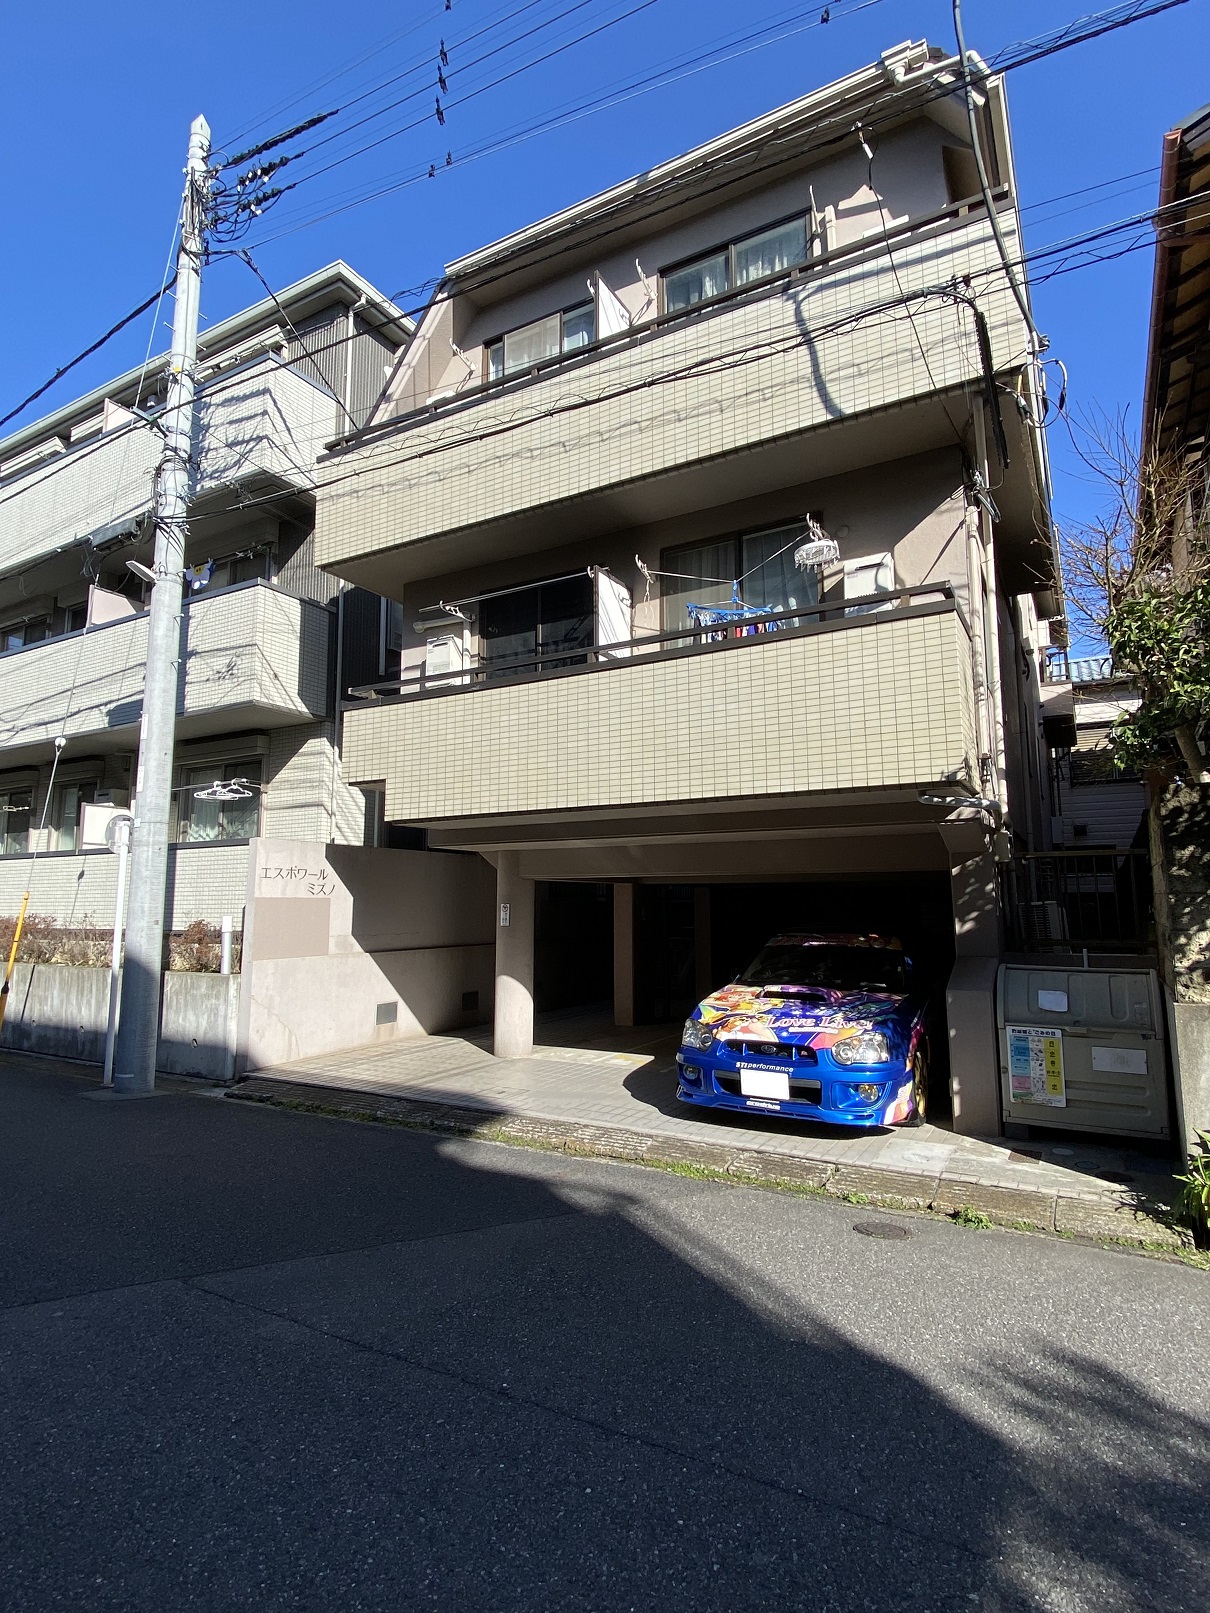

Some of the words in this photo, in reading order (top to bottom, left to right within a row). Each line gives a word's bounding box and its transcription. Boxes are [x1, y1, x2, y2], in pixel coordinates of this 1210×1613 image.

[260, 866, 328, 880] エスポワール
[307, 883, 335, 895] ミズノ
[766, 1017, 815, 1027] Love
[819, 1016, 874, 1030] Live!
